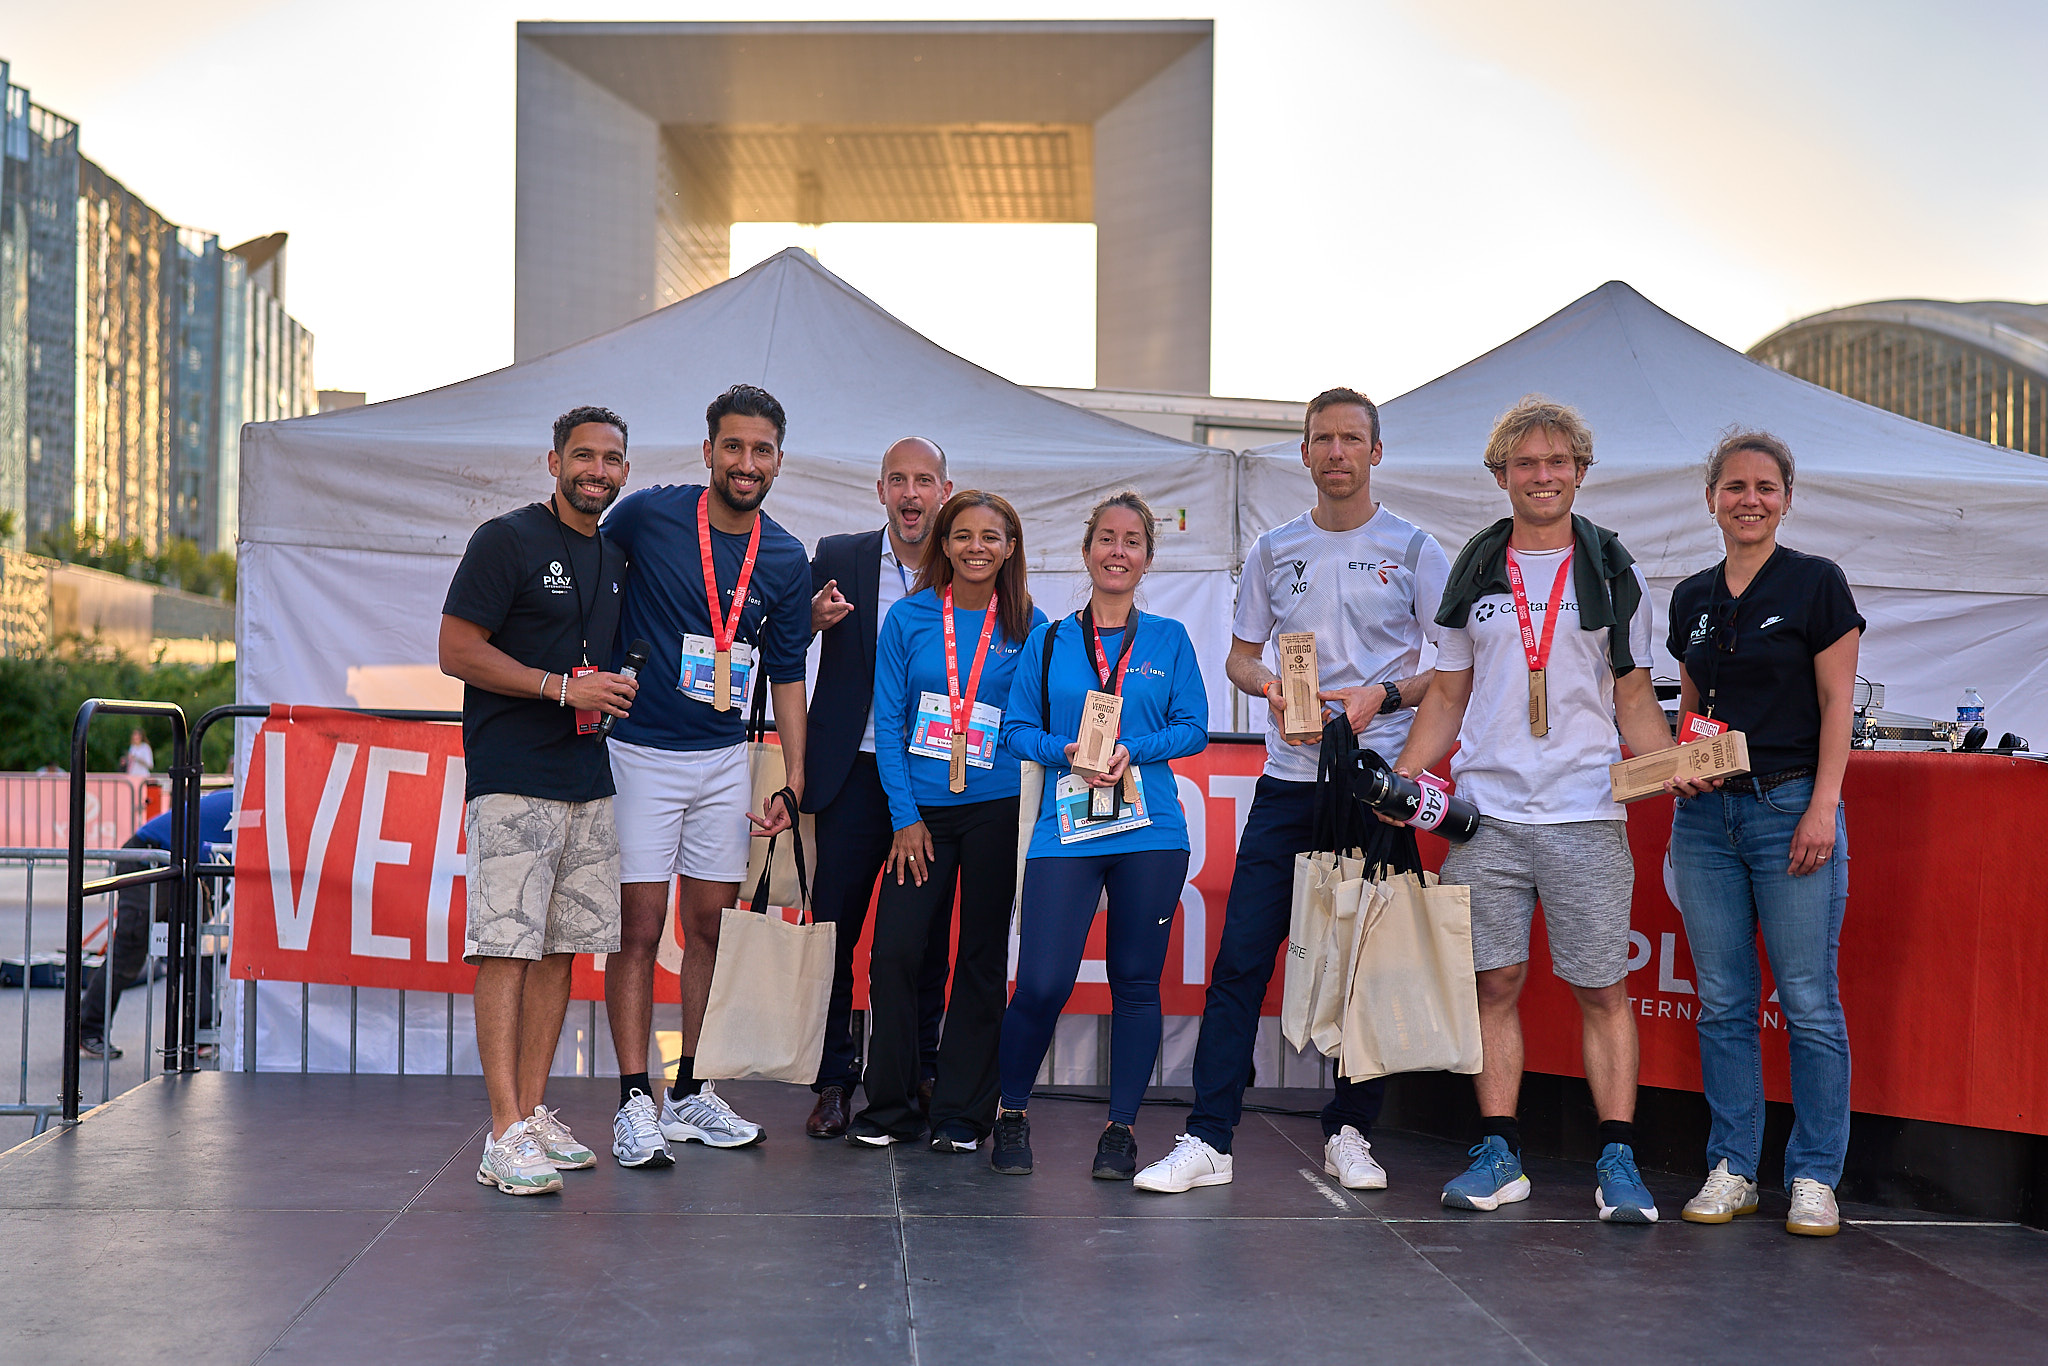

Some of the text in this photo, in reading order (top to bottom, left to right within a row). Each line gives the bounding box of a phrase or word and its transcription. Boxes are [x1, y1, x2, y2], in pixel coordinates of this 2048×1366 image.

[1348, 561, 1377, 571] ETF
[543, 575, 571, 586] PLAY
[1291, 581, 1307, 595] XG
[1521, 625, 1534, 649] VERTIGO
[1285, 644, 1312, 654] VERTIGO
[1289, 662, 1310, 670] PLAY
[1092, 702, 1115, 714] VERTIGO
[1092, 717, 1108, 725] PLAY
[1692, 719, 1720, 737] VERTIGO
[1693, 748, 1702, 771] PLAY
[1711, 740, 1725, 769] VERTIGO
[1421, 787, 1443, 824] 646
[265, 731, 467, 963] VE
